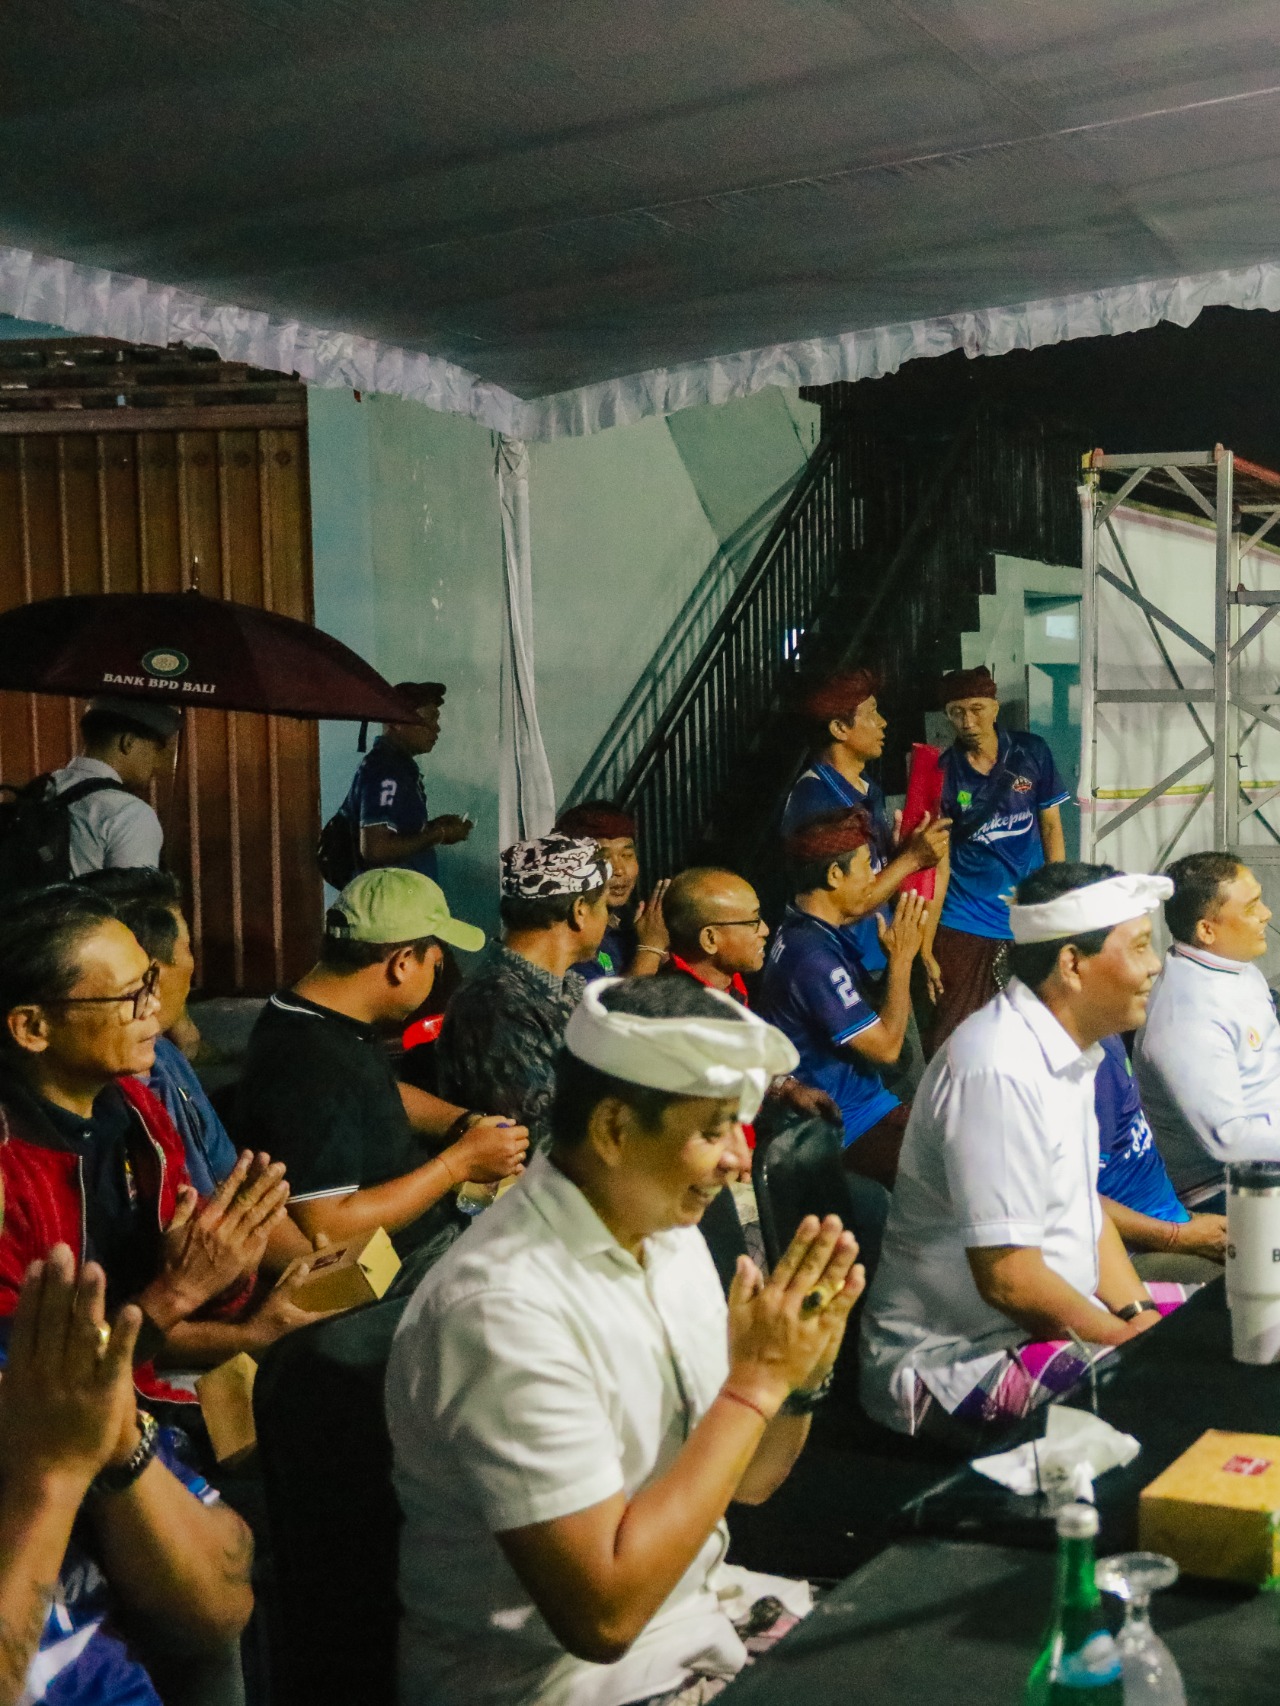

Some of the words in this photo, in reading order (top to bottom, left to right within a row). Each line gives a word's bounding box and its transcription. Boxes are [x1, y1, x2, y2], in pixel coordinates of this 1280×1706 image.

[103, 673, 145, 686] BANK
[148, 678, 179, 690] BPD
[182, 682, 216, 693] BALI
[380, 779, 397, 806] 2
[829, 966, 861, 1009] 2
